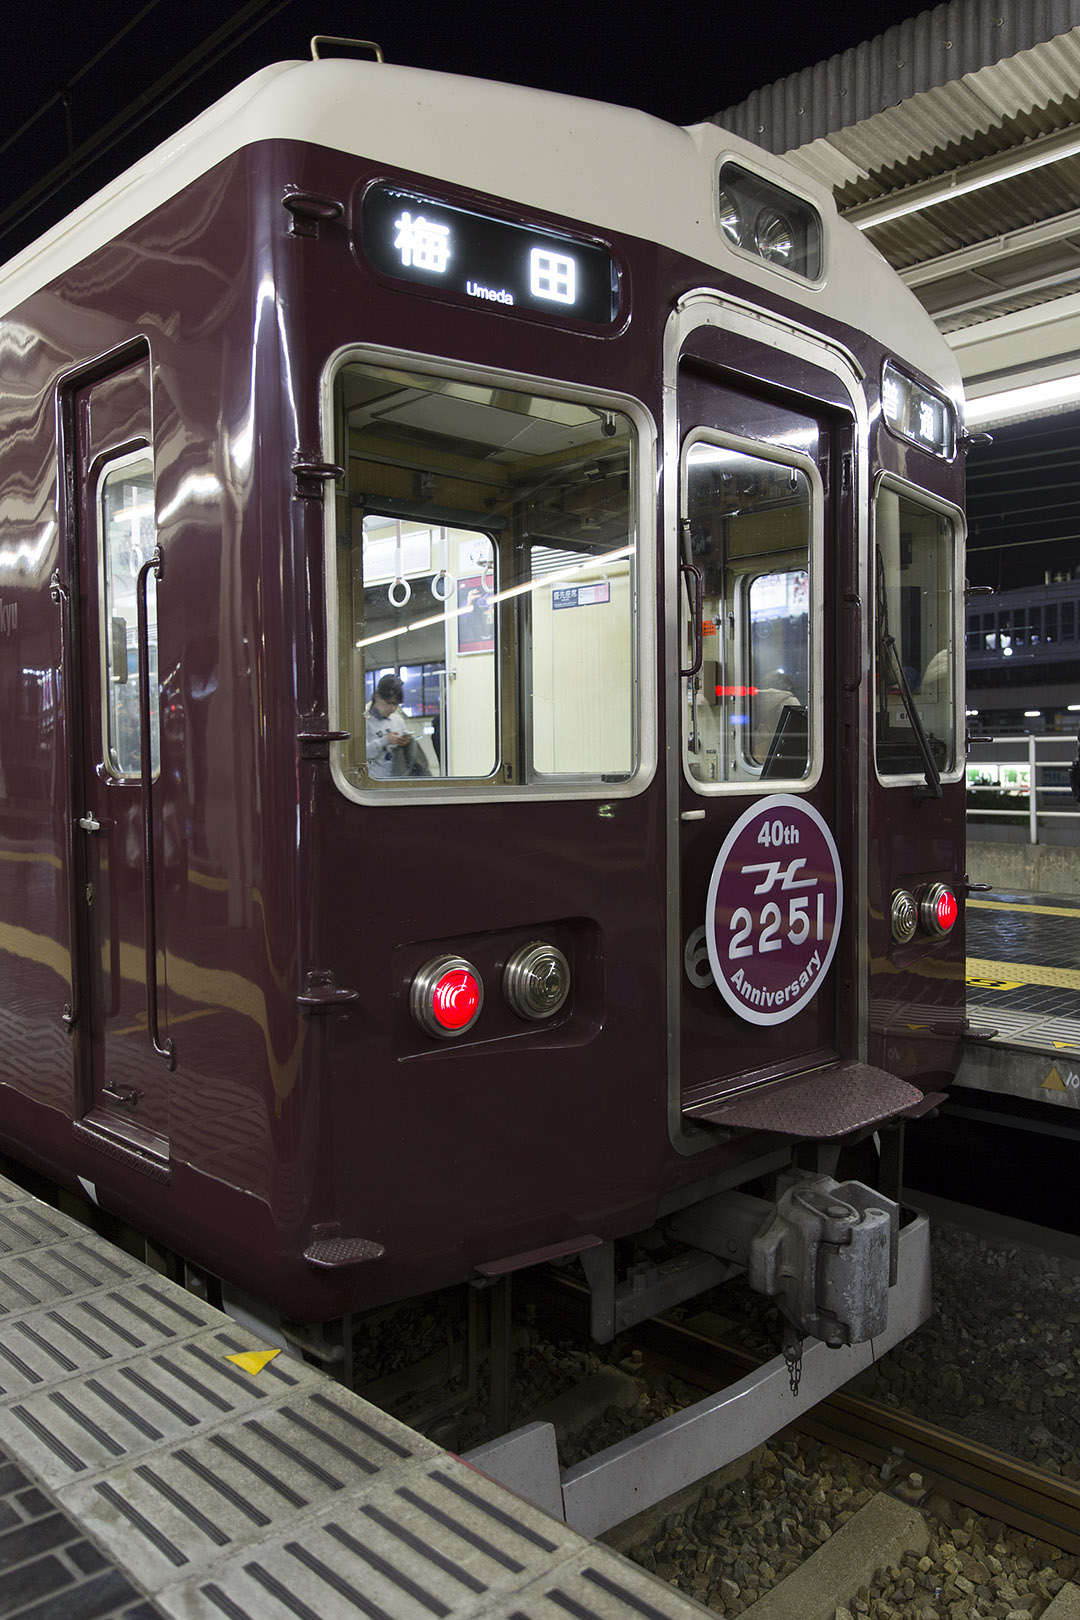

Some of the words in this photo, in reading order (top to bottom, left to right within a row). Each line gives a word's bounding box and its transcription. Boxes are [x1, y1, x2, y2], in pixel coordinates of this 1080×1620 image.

[466, 280, 514, 305] Umeda
[757, 819, 800, 847] 40th
[728, 892, 825, 960] 2251
[730, 949, 822, 1007] Anniversary
